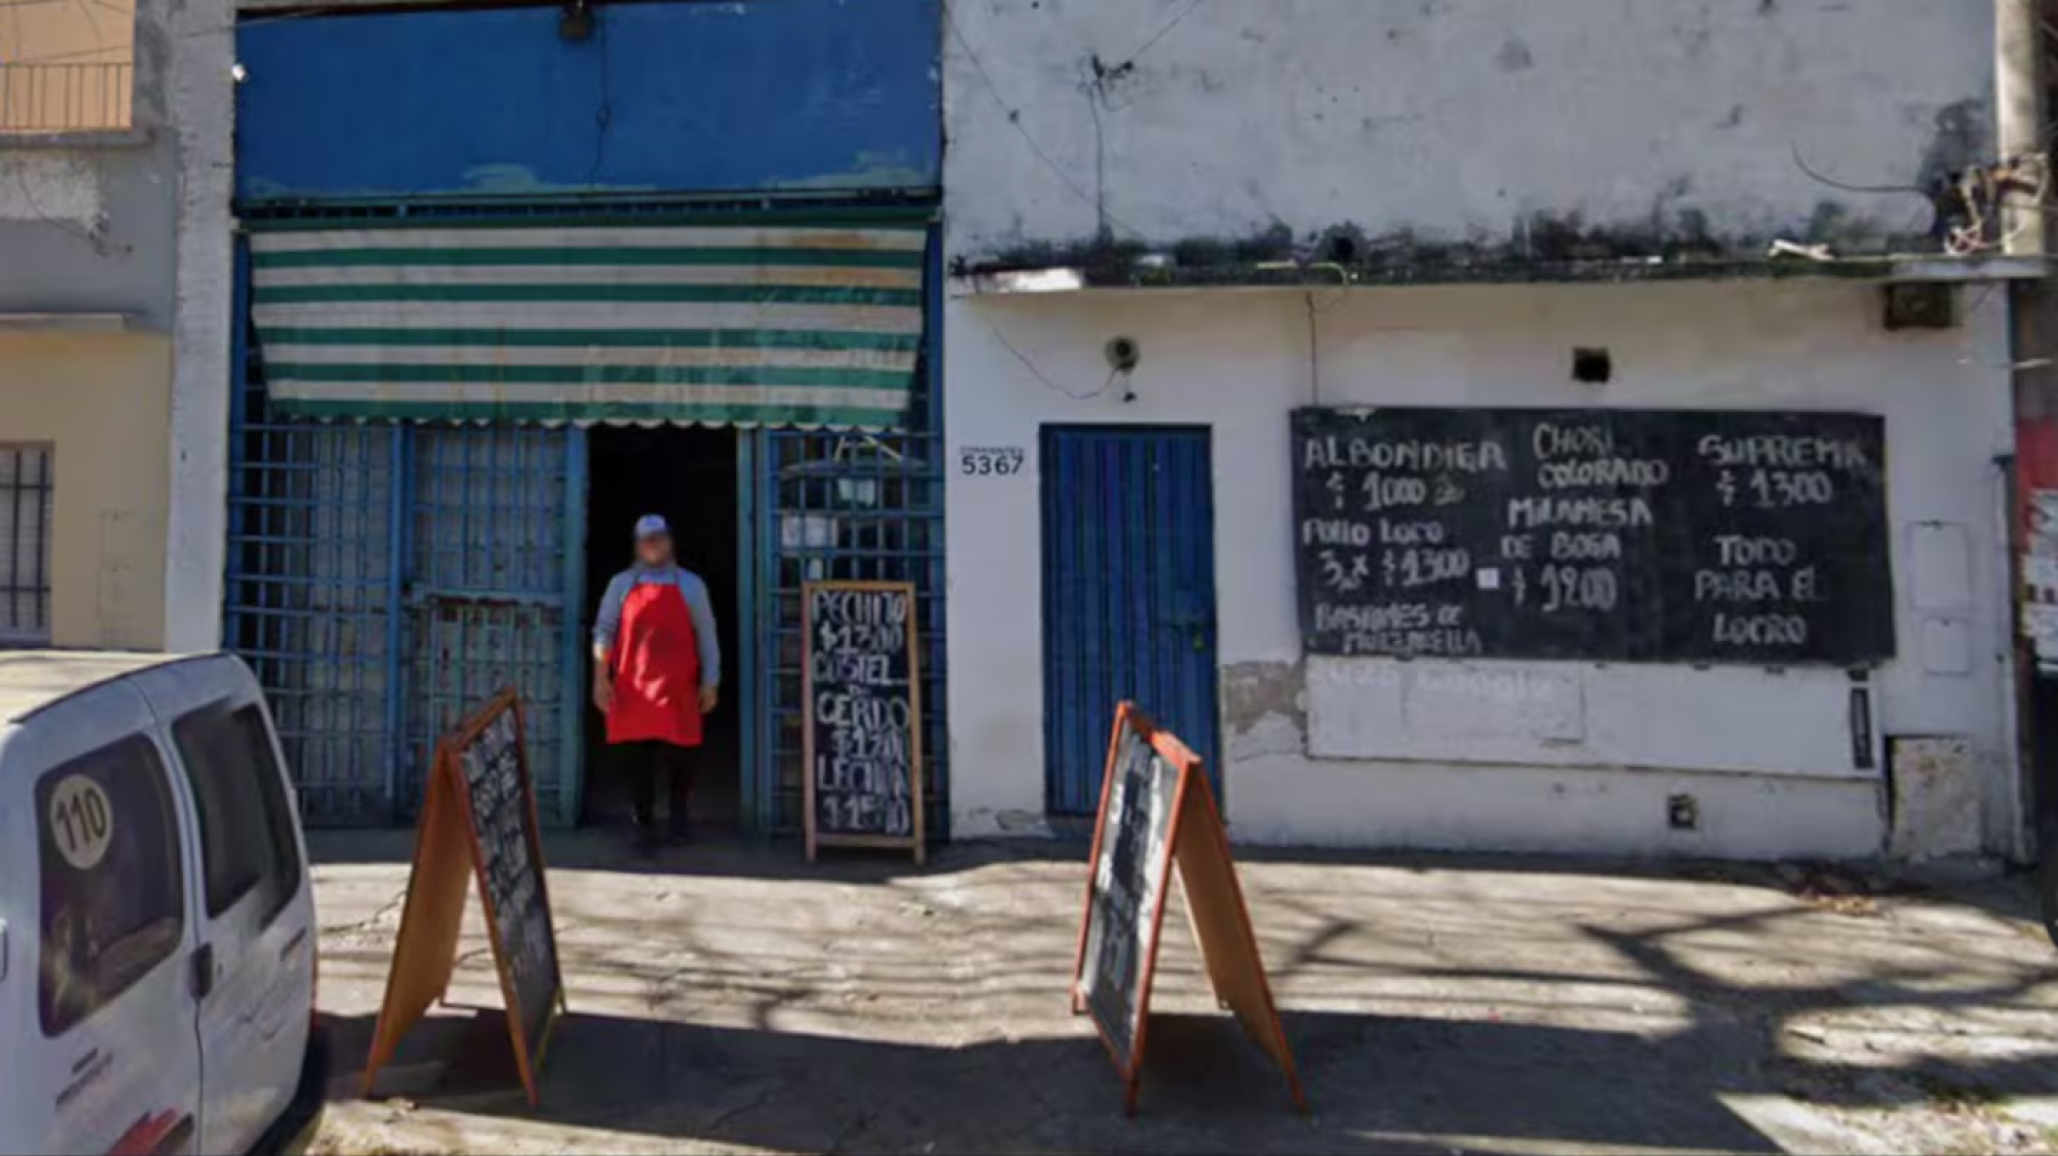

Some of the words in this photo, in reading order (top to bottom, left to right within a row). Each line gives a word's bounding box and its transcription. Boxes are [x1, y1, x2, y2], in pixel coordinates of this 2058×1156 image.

[961, 454, 1024, 476] 5367
[1698, 434, 1868, 470] SUPREMA
[1537, 458, 1669, 488] COLORADO
[1750, 469, 1833, 509] 1300
[1364, 472, 1427, 512] 1000
[1714, 535, 1798, 567] TODO
[1694, 570, 1782, 602] PARA
[816, 691, 911, 732] CERDO
[55, 786, 107, 851] 110
